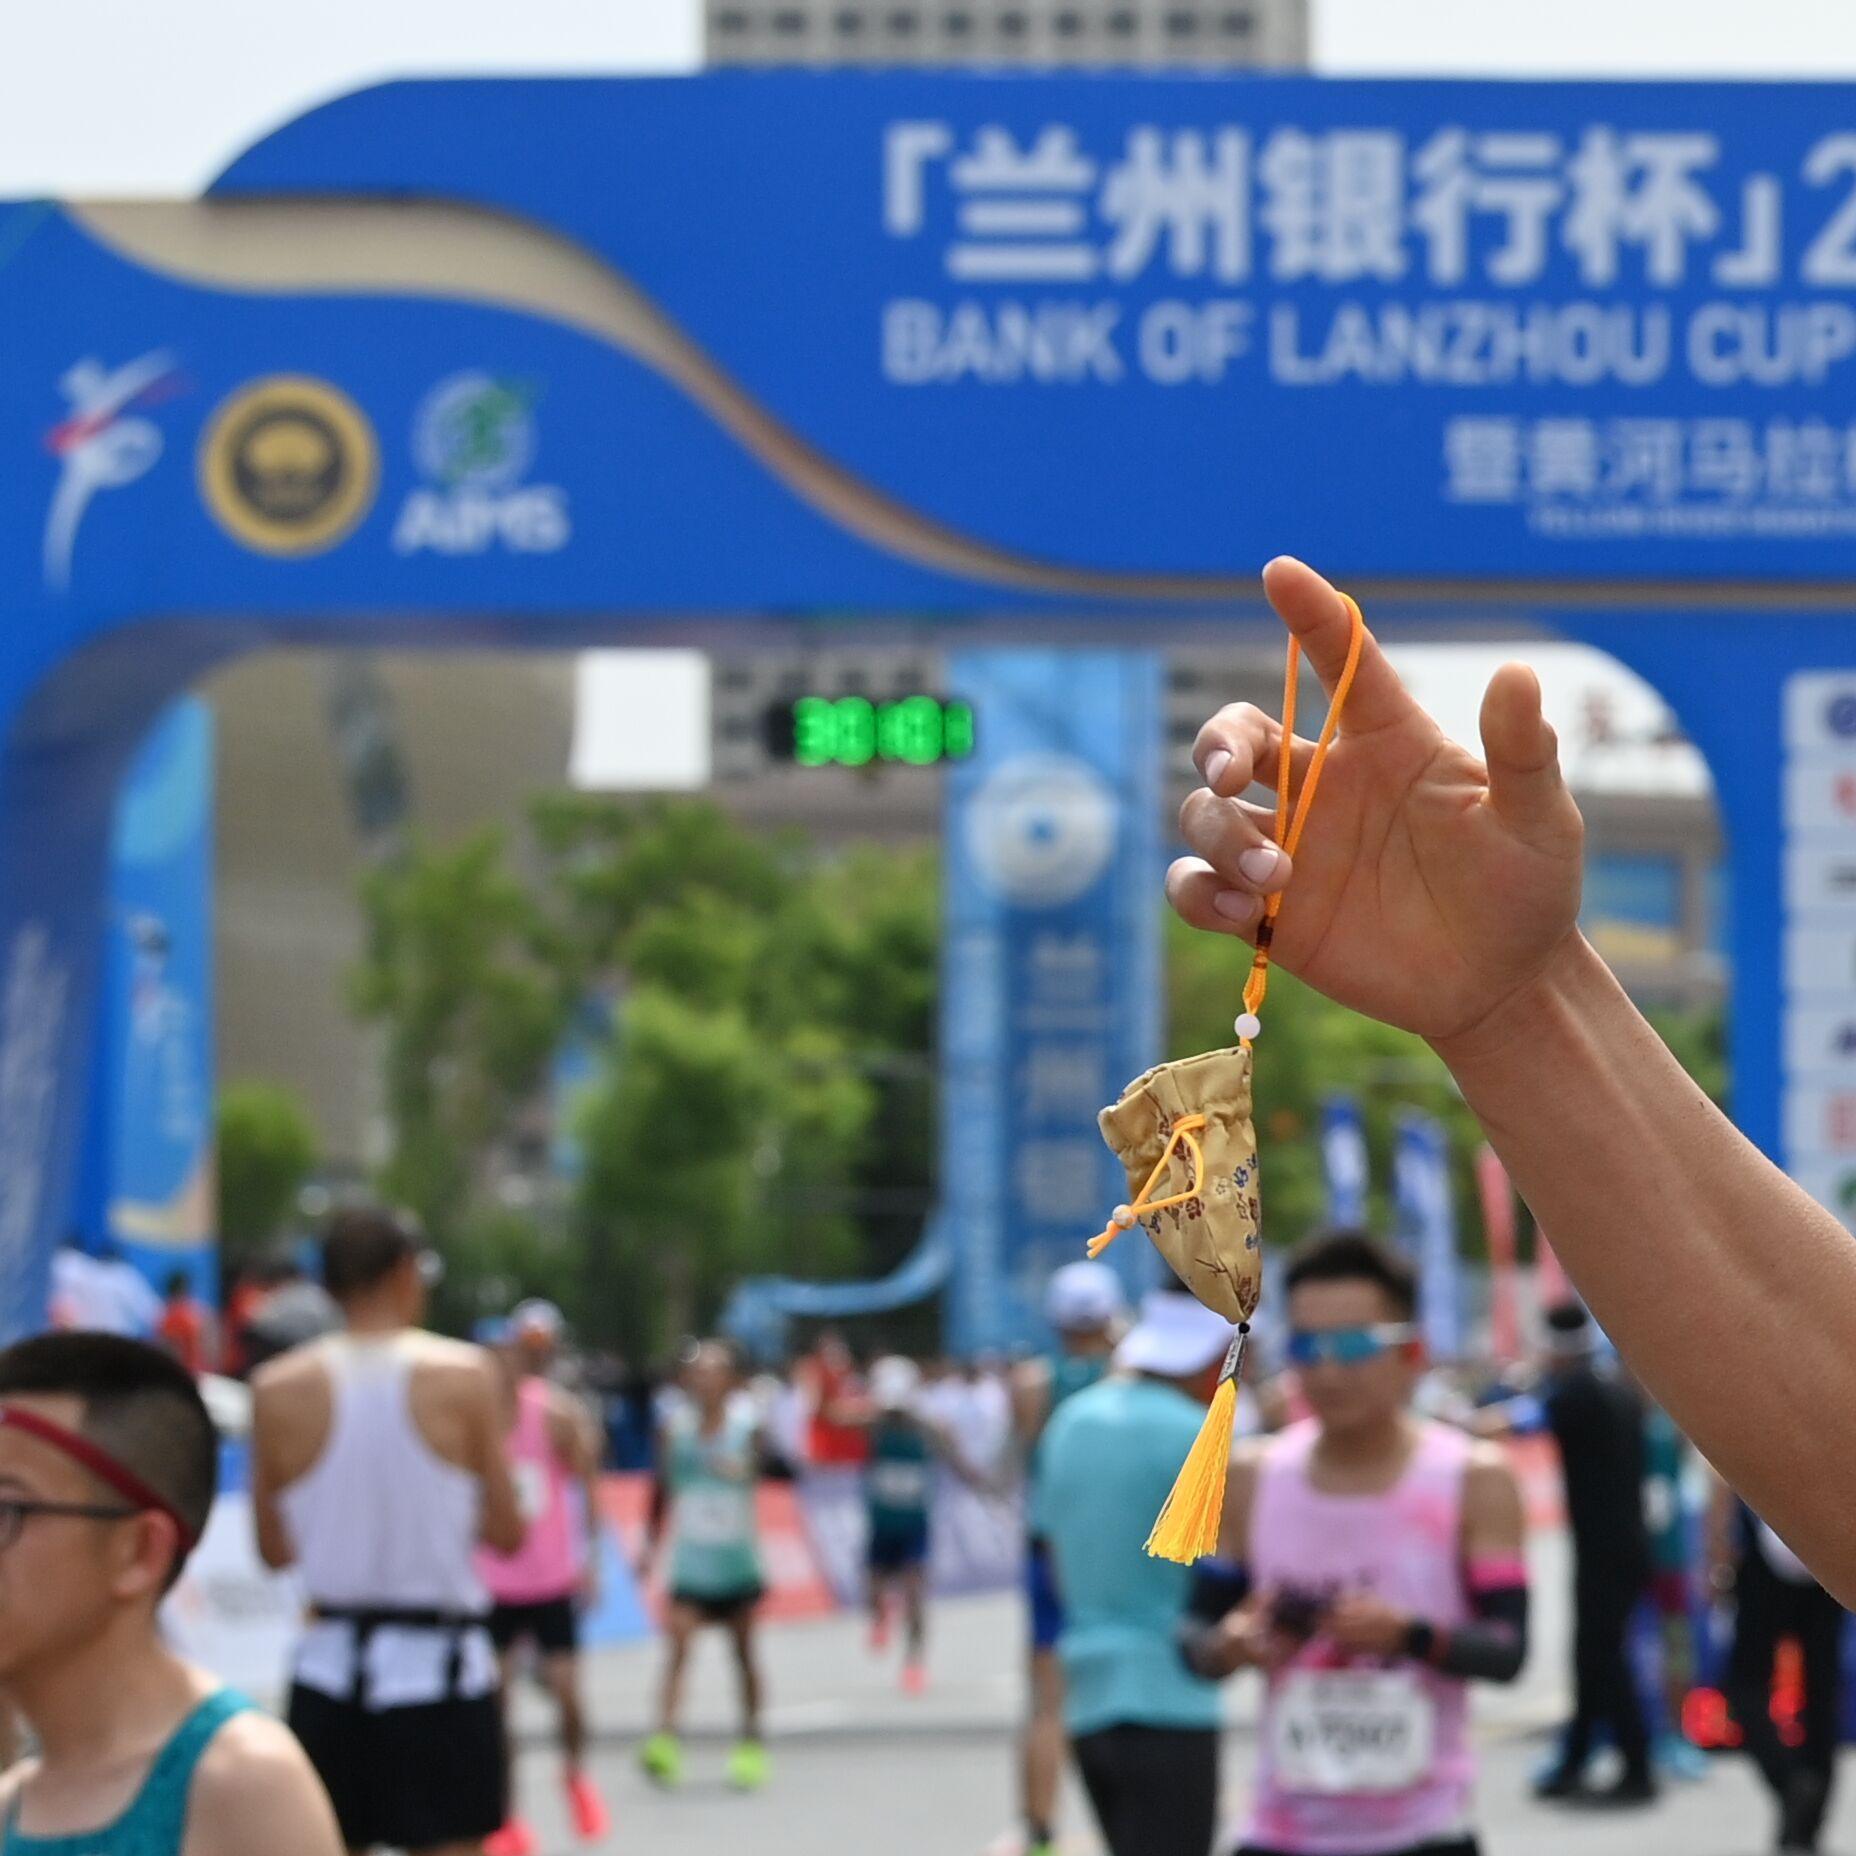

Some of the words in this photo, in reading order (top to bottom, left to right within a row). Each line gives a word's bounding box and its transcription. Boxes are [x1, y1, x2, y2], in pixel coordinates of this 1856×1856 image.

[882, 302, 1123, 386] BANK
[1136, 302, 1252, 386] OF
[1267, 302, 1668, 386] LANZHOU
